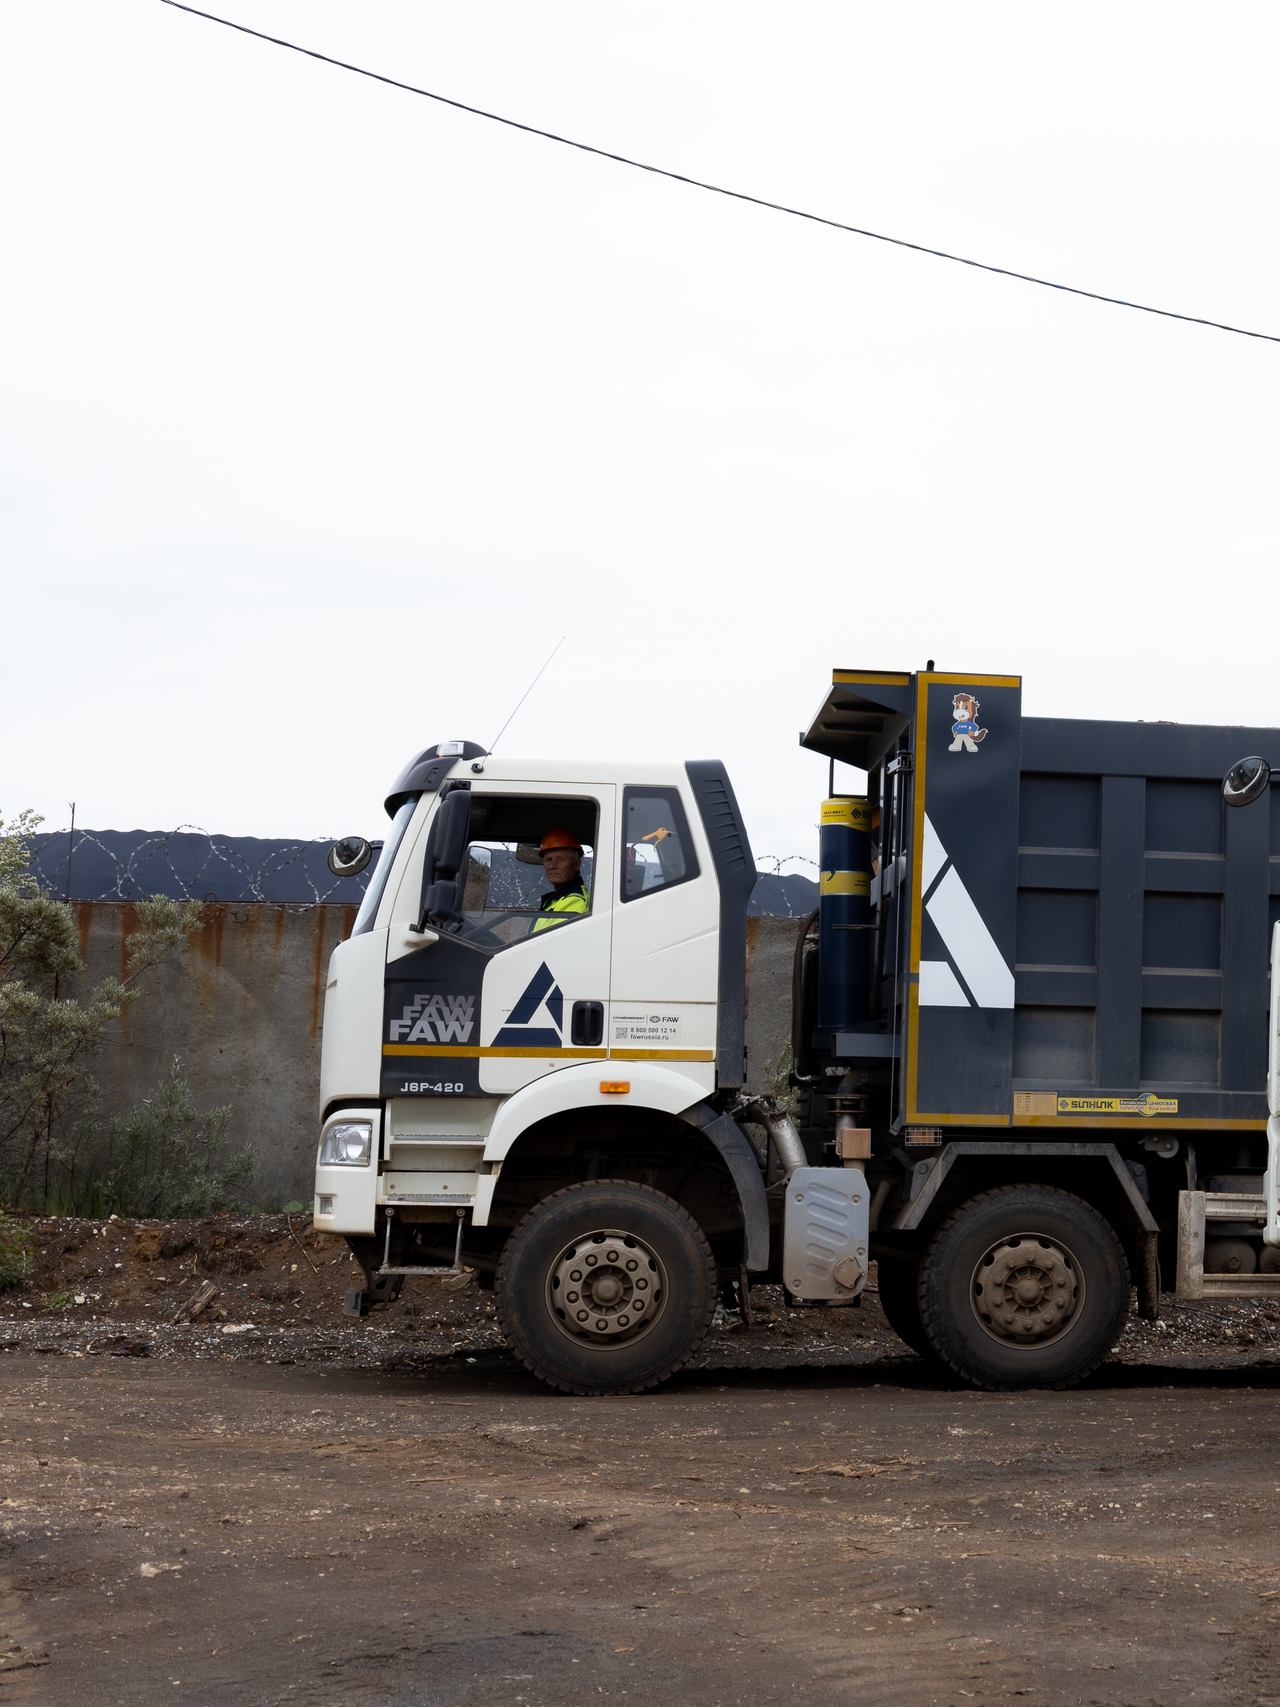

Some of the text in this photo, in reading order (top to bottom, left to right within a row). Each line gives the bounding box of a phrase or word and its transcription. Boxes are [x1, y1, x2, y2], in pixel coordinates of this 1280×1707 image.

[414, 994, 475, 1011] FAW
[403, 1005, 475, 1025] FAW
[389, 1019, 474, 1042] FAW
[400, 1082, 464, 1093] J6P-420
[1071, 1100, 1114, 1109] SUNHUNK
